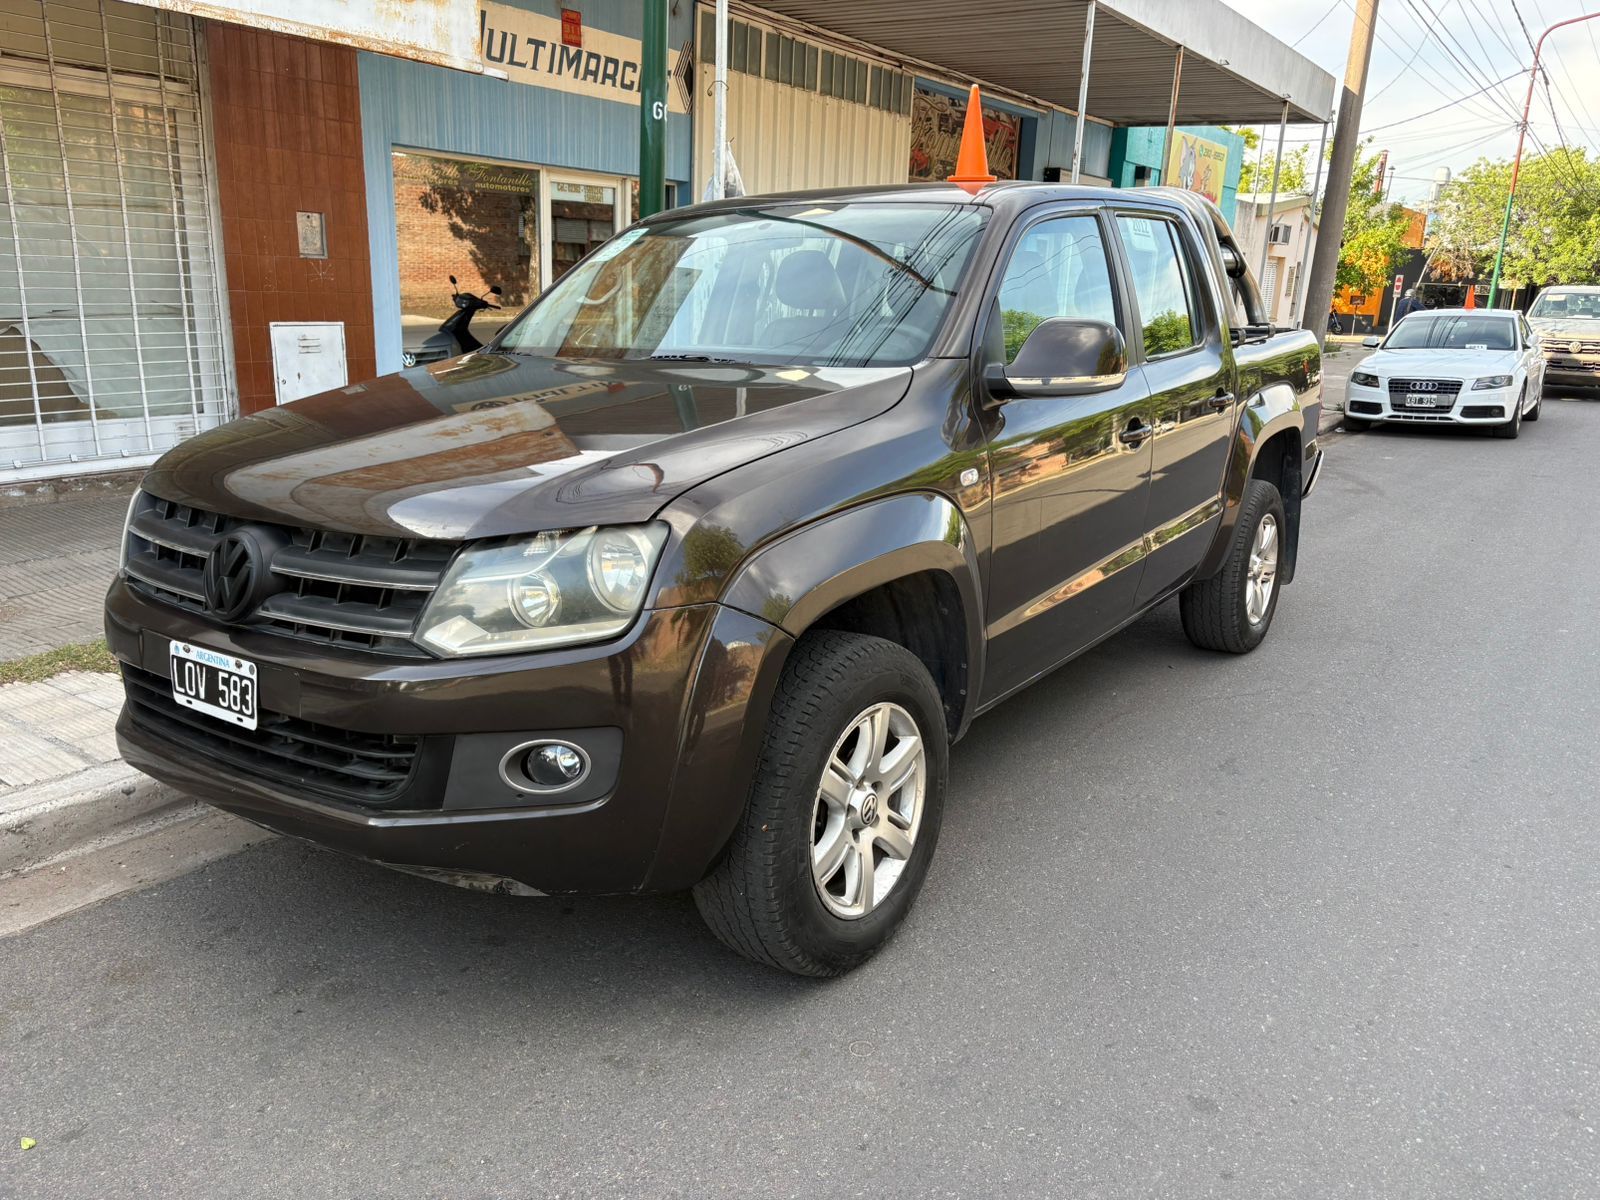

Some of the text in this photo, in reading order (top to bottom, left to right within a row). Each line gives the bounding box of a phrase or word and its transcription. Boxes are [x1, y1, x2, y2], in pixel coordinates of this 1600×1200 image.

[480, 9, 671, 93] ULTIMARC
[475, 181, 530, 193] automotores
[196, 650, 230, 668] ARGENTINA
[173, 658, 252, 716] LOV 583
